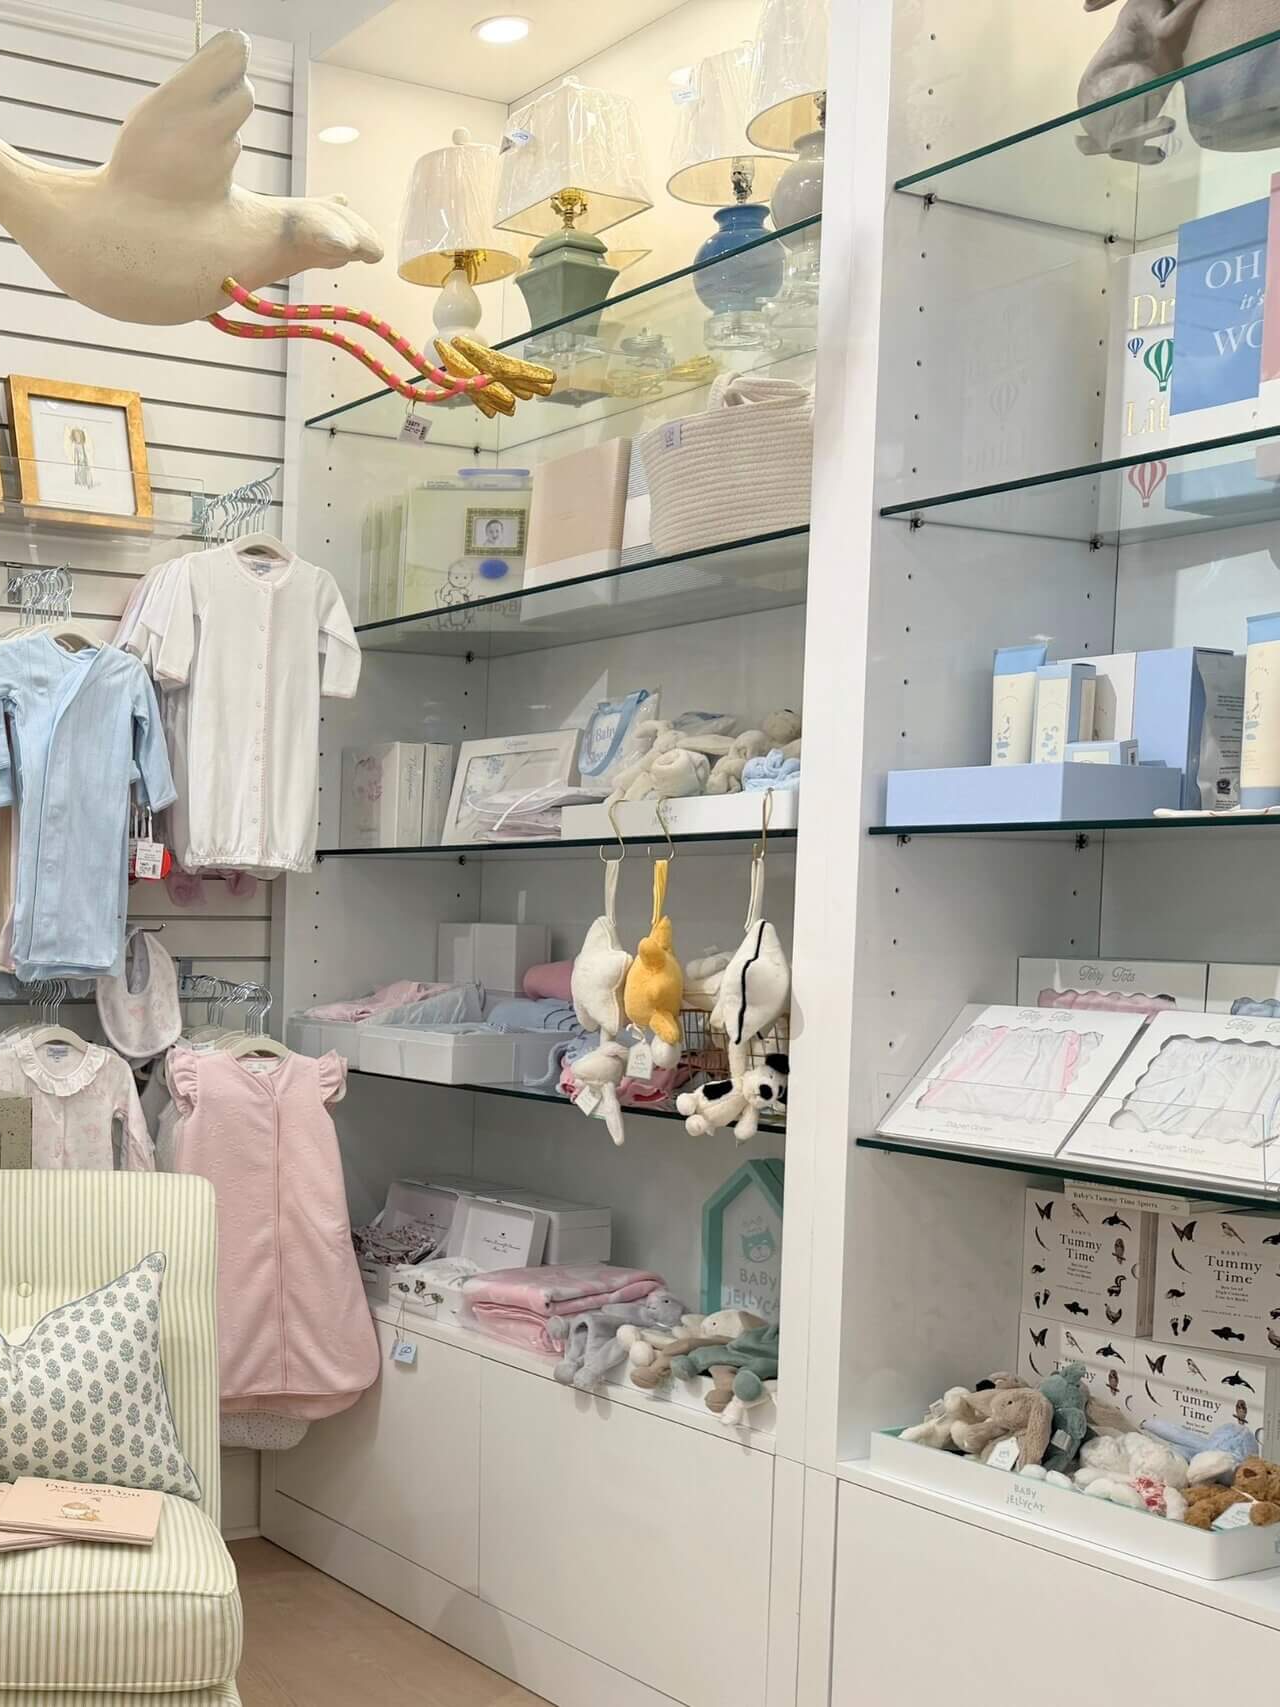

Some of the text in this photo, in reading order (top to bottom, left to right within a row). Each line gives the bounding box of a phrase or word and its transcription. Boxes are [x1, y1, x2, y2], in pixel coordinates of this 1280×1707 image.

[1205, 250, 1263, 289] OH
[1239, 287, 1265, 311] it's
[1131, 294, 1176, 332] Dr
[1126, 397, 1169, 437] Lit
[1073, 1191, 1095, 1202] Baby's
[1096, 1194, 1118, 1205] Tummy
[1119, 1197, 1136, 1207] Time
[1059, 1233, 1103, 1254] Tummy
[1066, 1248, 1095, 1263] Time
[1204, 1255, 1262, 1274] Tummy
[739, 1268, 777, 1292] BABY
[1213, 1270, 1253, 1285] Time
[1173, 1389, 1221, 1413] Tummy
[1180, 1404, 1214, 1423] Time
[1013, 1483, 1037, 1498] BABY
[1005, 1495, 1046, 1513] JELLYCAT
